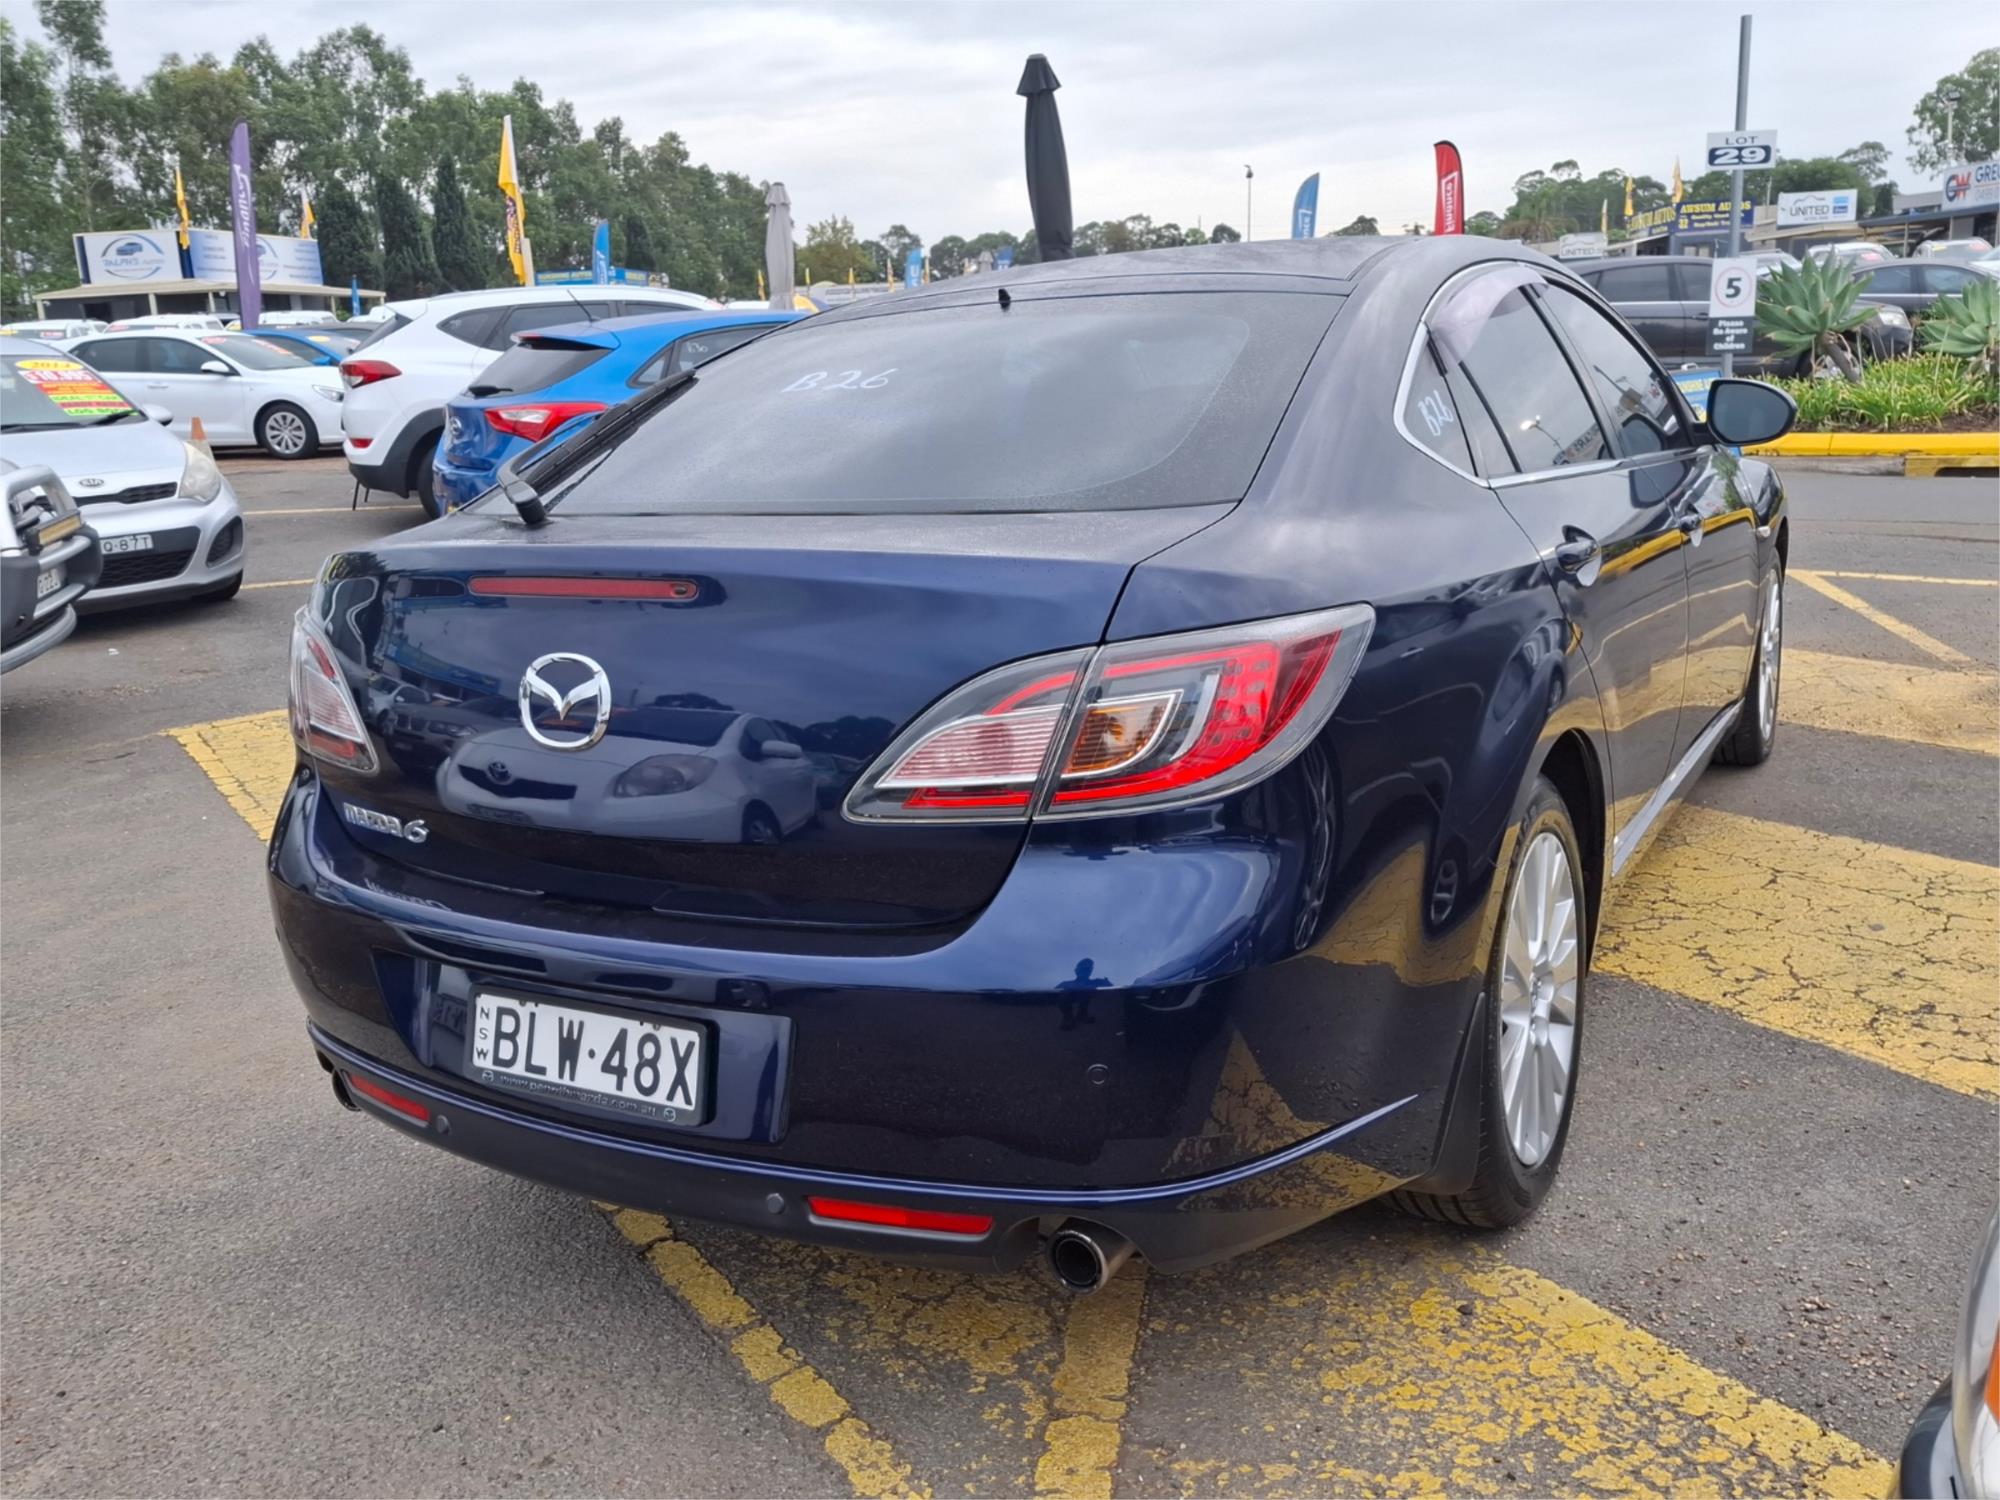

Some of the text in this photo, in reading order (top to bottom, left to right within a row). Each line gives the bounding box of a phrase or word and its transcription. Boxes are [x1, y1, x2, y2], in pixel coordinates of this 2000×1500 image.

[1726, 136, 1757, 145] LOT
[1713, 147, 1766, 164] 29
[1790, 205, 1829, 217] UNITED
[1725, 277, 1742, 298] 5
[780, 368, 898, 393] B26
